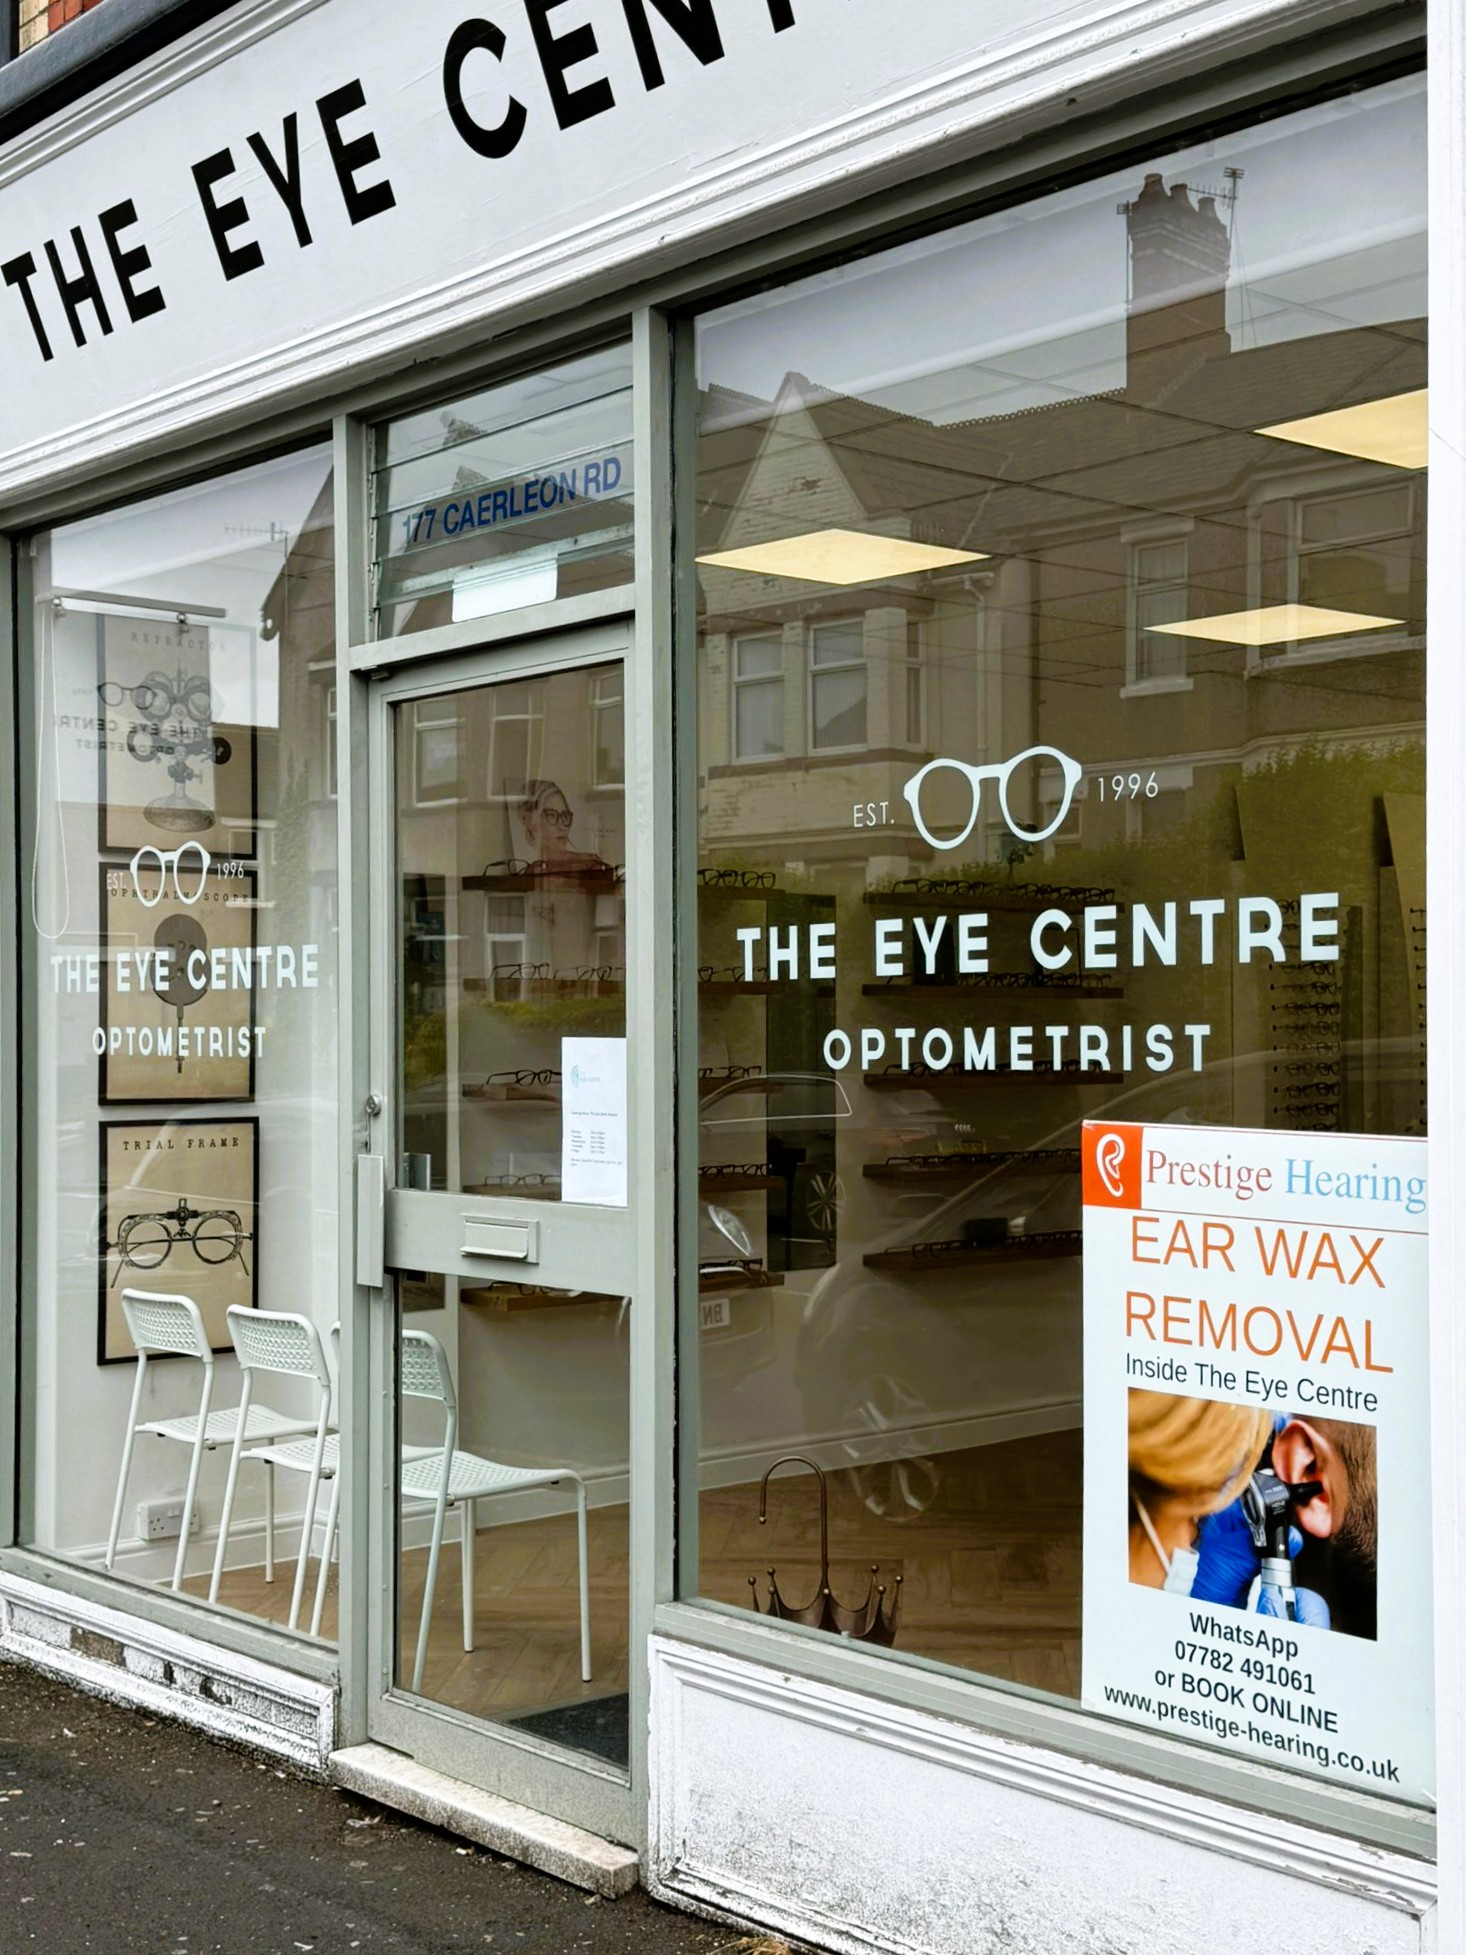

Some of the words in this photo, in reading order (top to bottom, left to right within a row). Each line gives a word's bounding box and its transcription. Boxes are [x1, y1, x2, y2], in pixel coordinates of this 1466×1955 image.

[1, 198, 166, 362] THE
[191, 79, 397, 281] EYE
[443, 0, 796, 159] CEN
[402, 507, 436, 544] 177
[443, 468, 577, 535] CAERLEON
[583, 456, 621, 496] RD
[853, 801, 895, 828] EST.
[1097, 771, 1160, 803] 1996
[216, 861, 245, 881] 1996
[736, 922, 836, 982] THE
[875, 912, 989, 977] EYE
[1029, 892, 1340, 970] CENTRE
[51, 954, 99, 994] THE
[116, 950, 170, 992] EYE
[187, 943, 319, 990] CENTRE
[91, 1026, 267, 1058] OPTOMETRIST
[822, 1023, 1211, 1072] OPTOMETRIST
[122, 1139, 175, 1151] TRIAL
[187, 1136, 240, 1149] FRAME
[1145, 1149, 1273, 1201] Prestige
[1285, 1158, 1427, 1215] Hearing
[1131, 1215, 1236, 1273] EAR
[1254, 1225, 1386, 1289] WAX
[1125, 1290, 1394, 1374] REMOVAL
[1125, 1352, 1188, 1383] Inside
[1195, 1362, 1237, 1391] The
[1245, 1369, 1289, 1402] Eye
[1296, 1378, 1379, 1412] Centre
[1189, 1612, 1299, 1662] WhatsApp
[1174, 1640, 1234, 1674] 07782
[1239, 1657, 1317, 1695] 491061
[1154, 1669, 1176, 1689] or
[1181, 1672, 1246, 1708] BOOK
[1251, 1691, 1339, 1734] ONLINE
[1103, 1684, 1401, 1784] www.prestige-hearing.co.uk
